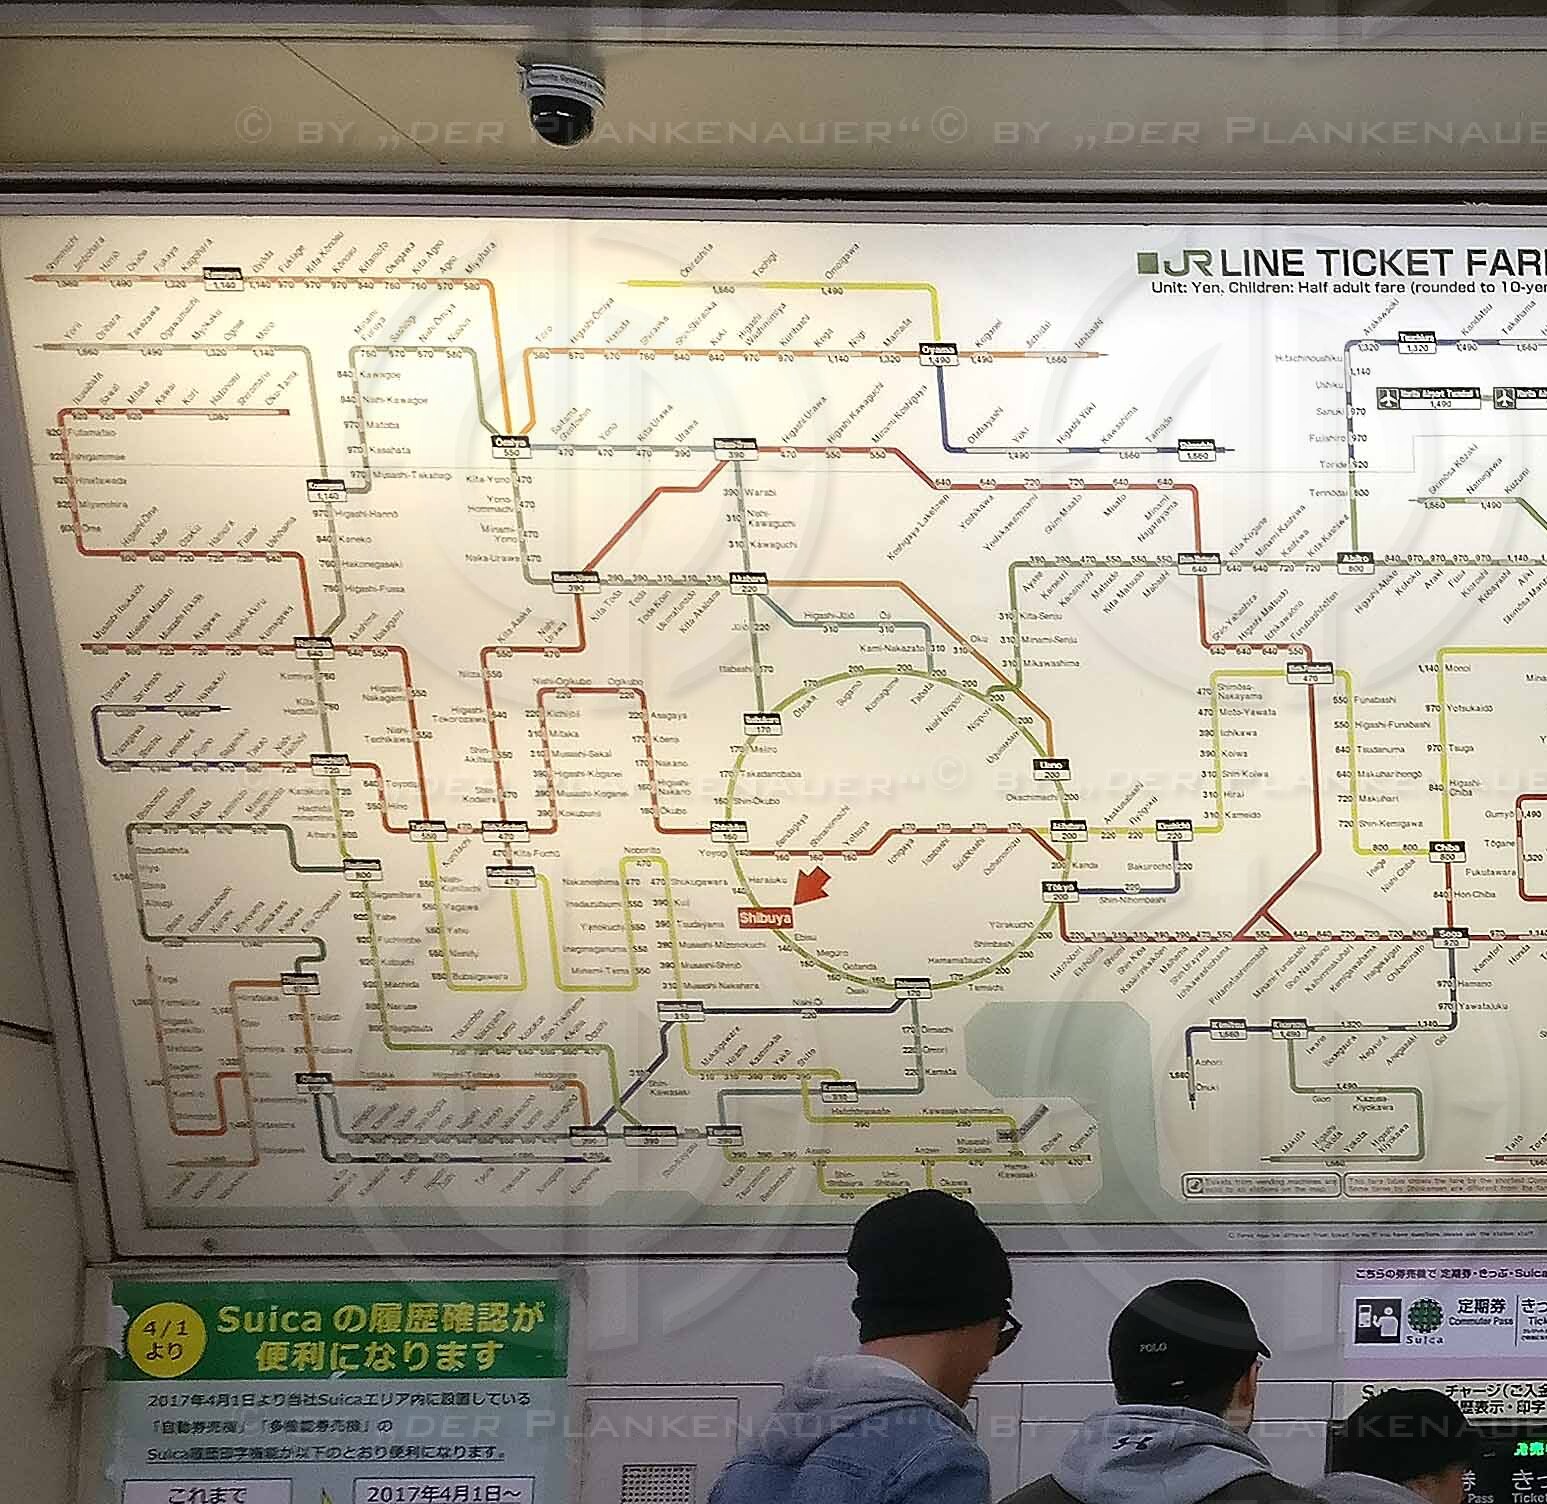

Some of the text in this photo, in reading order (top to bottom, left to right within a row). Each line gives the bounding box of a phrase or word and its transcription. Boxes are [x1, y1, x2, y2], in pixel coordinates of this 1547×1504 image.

[1164, 251, 1213, 276] JR
[1222, 250, 1304, 276] LINE
[1316, 250, 1453, 276] TICKET
[1152, 282, 1187, 293] Unit:
[1229, 281, 1294, 294] Children:
[1299, 281, 1329, 293] Half
[1333, 281, 1370, 293] adult
[1375, 281, 1405, 293] fare
[1411, 281, 1475, 294] (rounded
[1480, 282, 1495, 293] to
[1434, 842, 1461, 853] Chiba
[739, 911, 792, 926] Shibuya
[1458, 1298, 1506, 1314] 定期券
[216, 1301, 546, 1335] Suica の履歴確認が
[143, 1320, 188, 1337] 4/1
[145, 1342, 185, 1360] より
[255, 1340, 505, 1372] 便利になります
[1468, 1494, 1494, 1504] Pass
